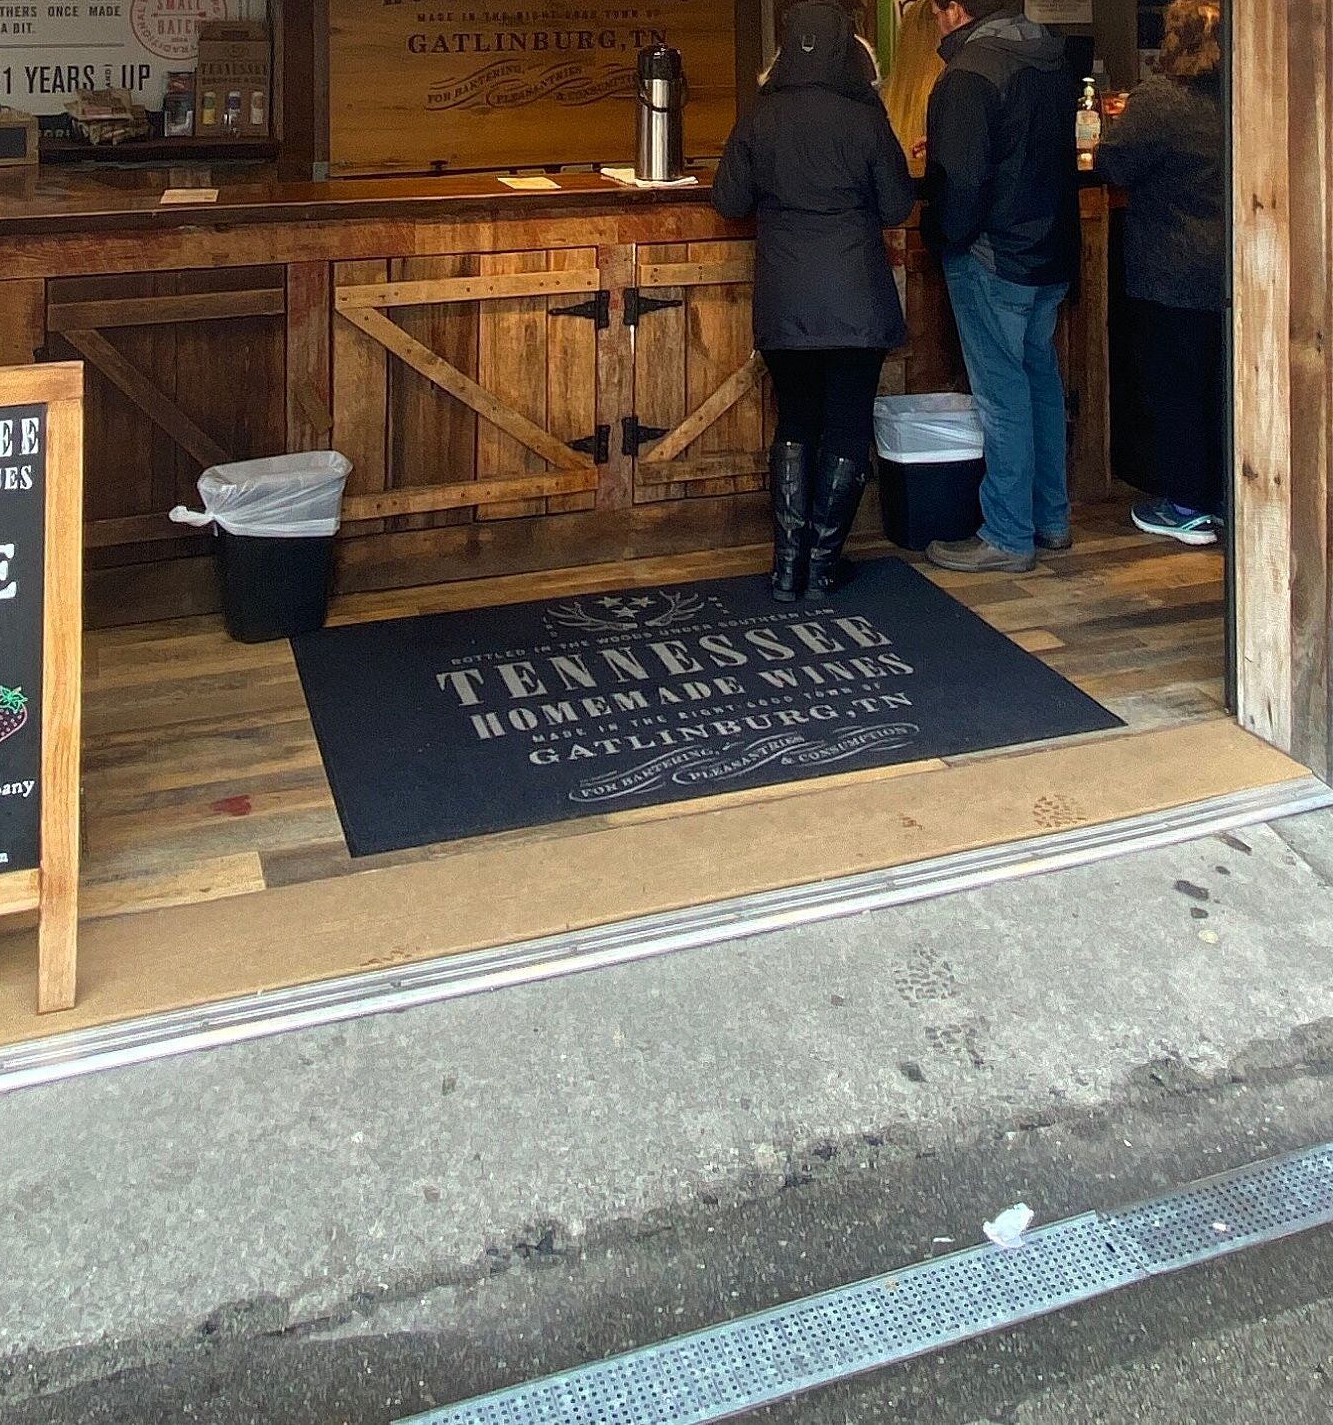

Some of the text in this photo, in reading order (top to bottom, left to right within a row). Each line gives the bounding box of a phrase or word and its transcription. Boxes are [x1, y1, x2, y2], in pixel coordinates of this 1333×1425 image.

[0, 23, 8, 34] A
[47, 6, 79, 18] ONCE
[89, 6, 121, 17] MADE
[25, 65, 95, 94] YEARS
[122, 64, 150, 91] UP
[435, 616, 893, 707] TENNESSEE
[451, 648, 526, 666] BOTTLED
[534, 644, 551, 654] IN
[560, 639, 590, 650] THE
[596, 632, 653, 645] WOODS
[660, 624, 712, 636] UNDER
[470, 653, 914, 740] HOMEMADE WINES
[532, 728, 587, 744] MADE
[599, 723, 617, 733] IN
[631, 715, 668, 727] THE
[804, 687, 853, 699] TOWN
[580, 782, 618, 798] FOR
[690, 735, 805, 780] PLEASANTRIES
[781, 756, 794, 766] &
[798, 726, 909, 763] CONSUMPTION
